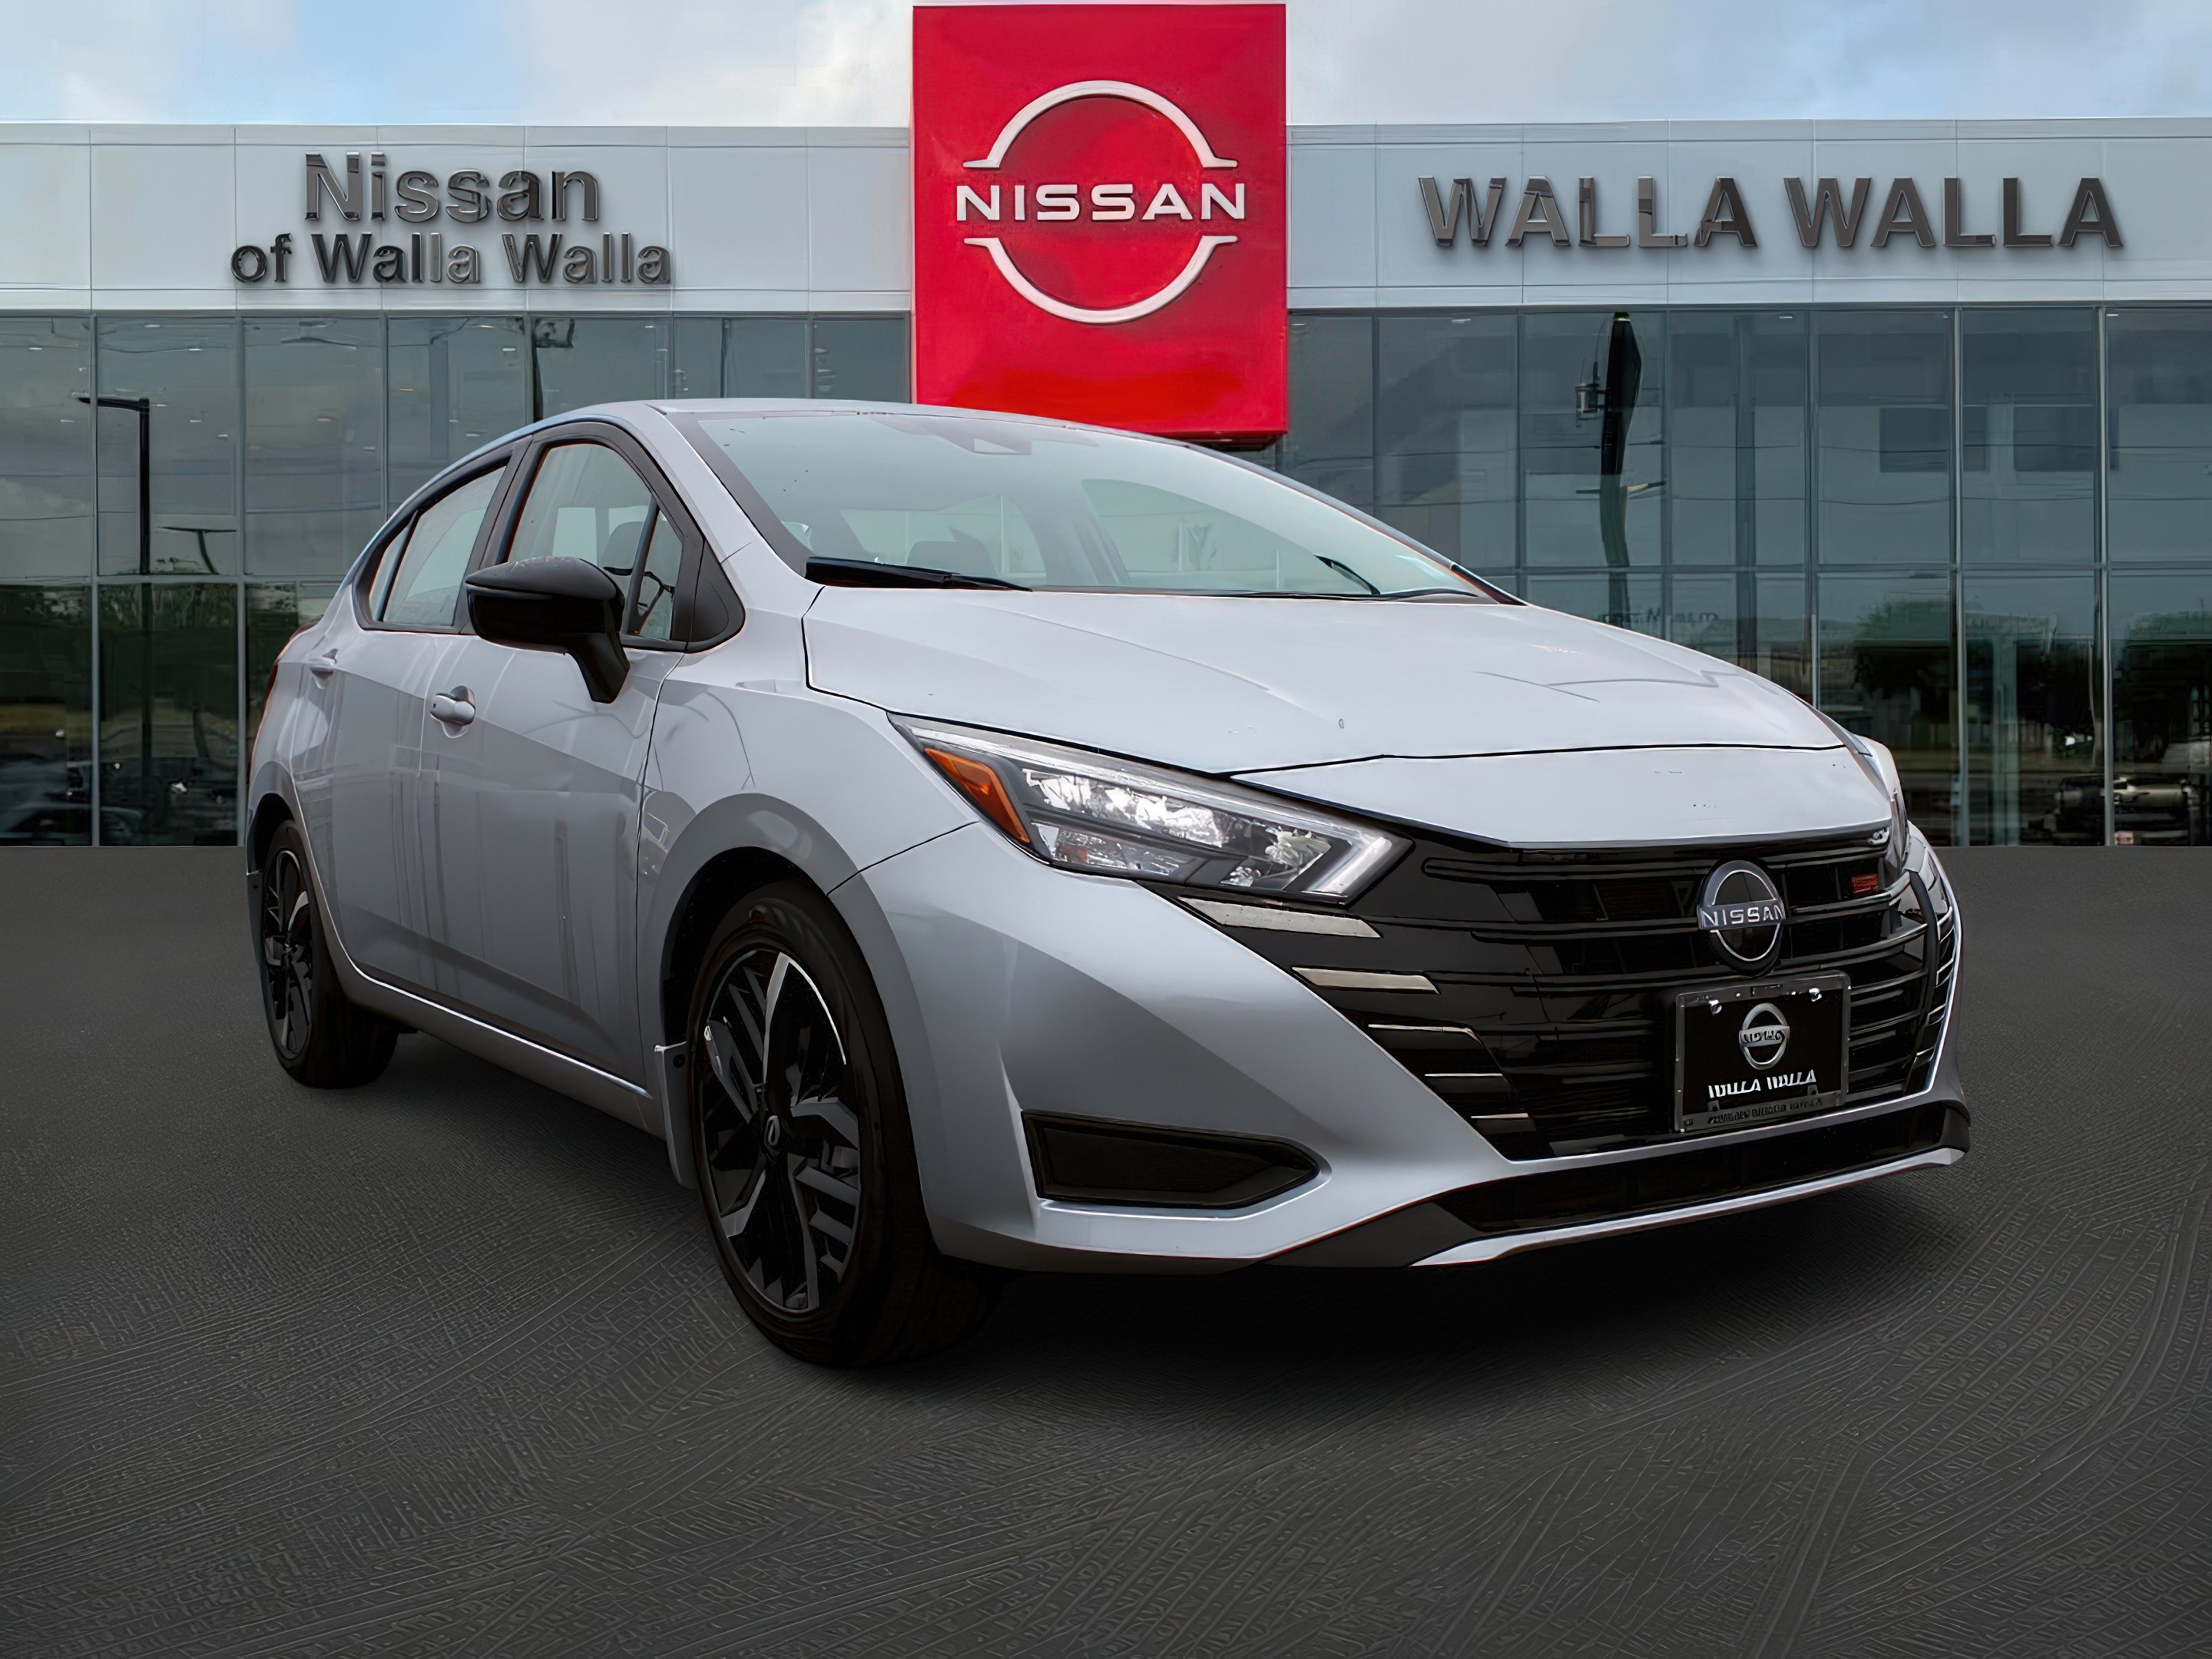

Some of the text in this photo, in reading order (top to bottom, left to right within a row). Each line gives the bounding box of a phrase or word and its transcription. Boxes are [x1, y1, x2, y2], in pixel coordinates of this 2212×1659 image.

[304, 151, 599, 223] Nissan
[956, 183, 1246, 221] NISSAN
[1417, 175, 2124, 248] WALLA WALLA
[230, 233, 672, 284] of Walla Walla
[1701, 904, 1783, 927] NISSAN
